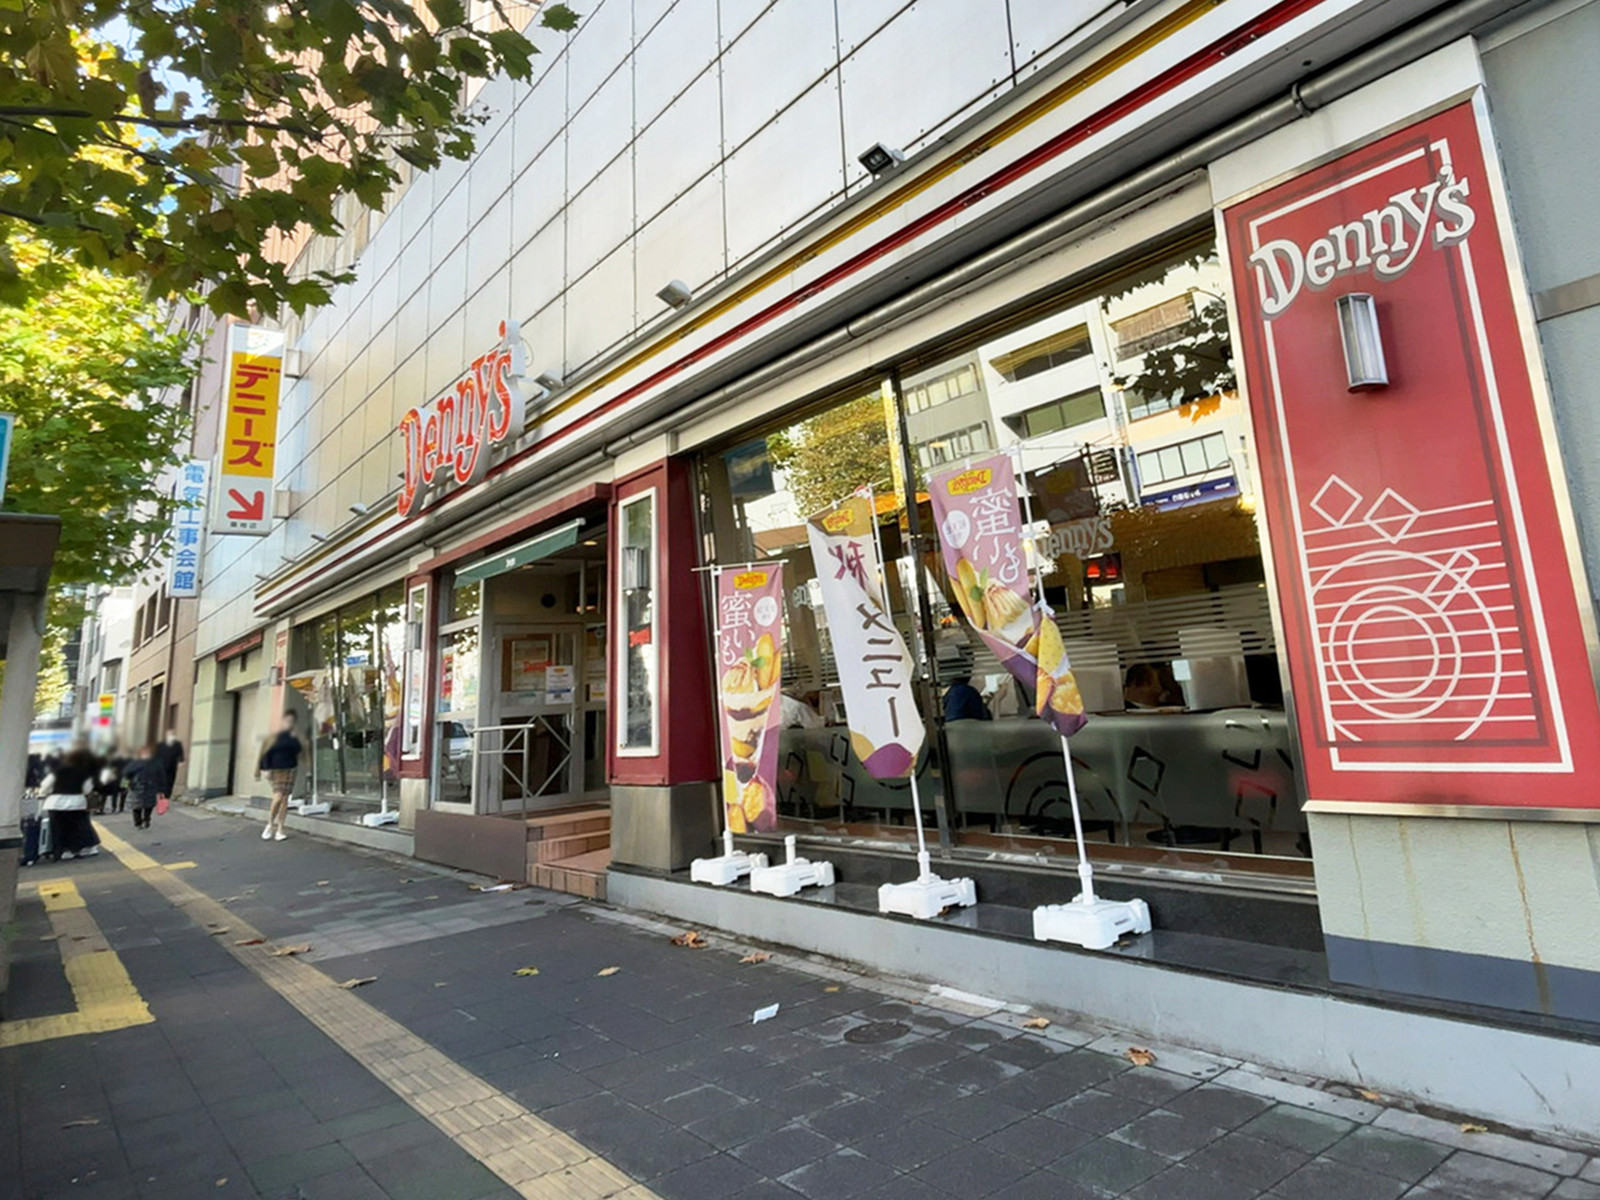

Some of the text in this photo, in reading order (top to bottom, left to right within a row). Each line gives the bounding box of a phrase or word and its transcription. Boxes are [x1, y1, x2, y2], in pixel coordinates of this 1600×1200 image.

[1249, 164, 1476, 314] Denny's
[227, 363, 281, 467] デニーズ
[397, 319, 513, 517] Denny's
[721, 590, 756, 665] 蜜いも
